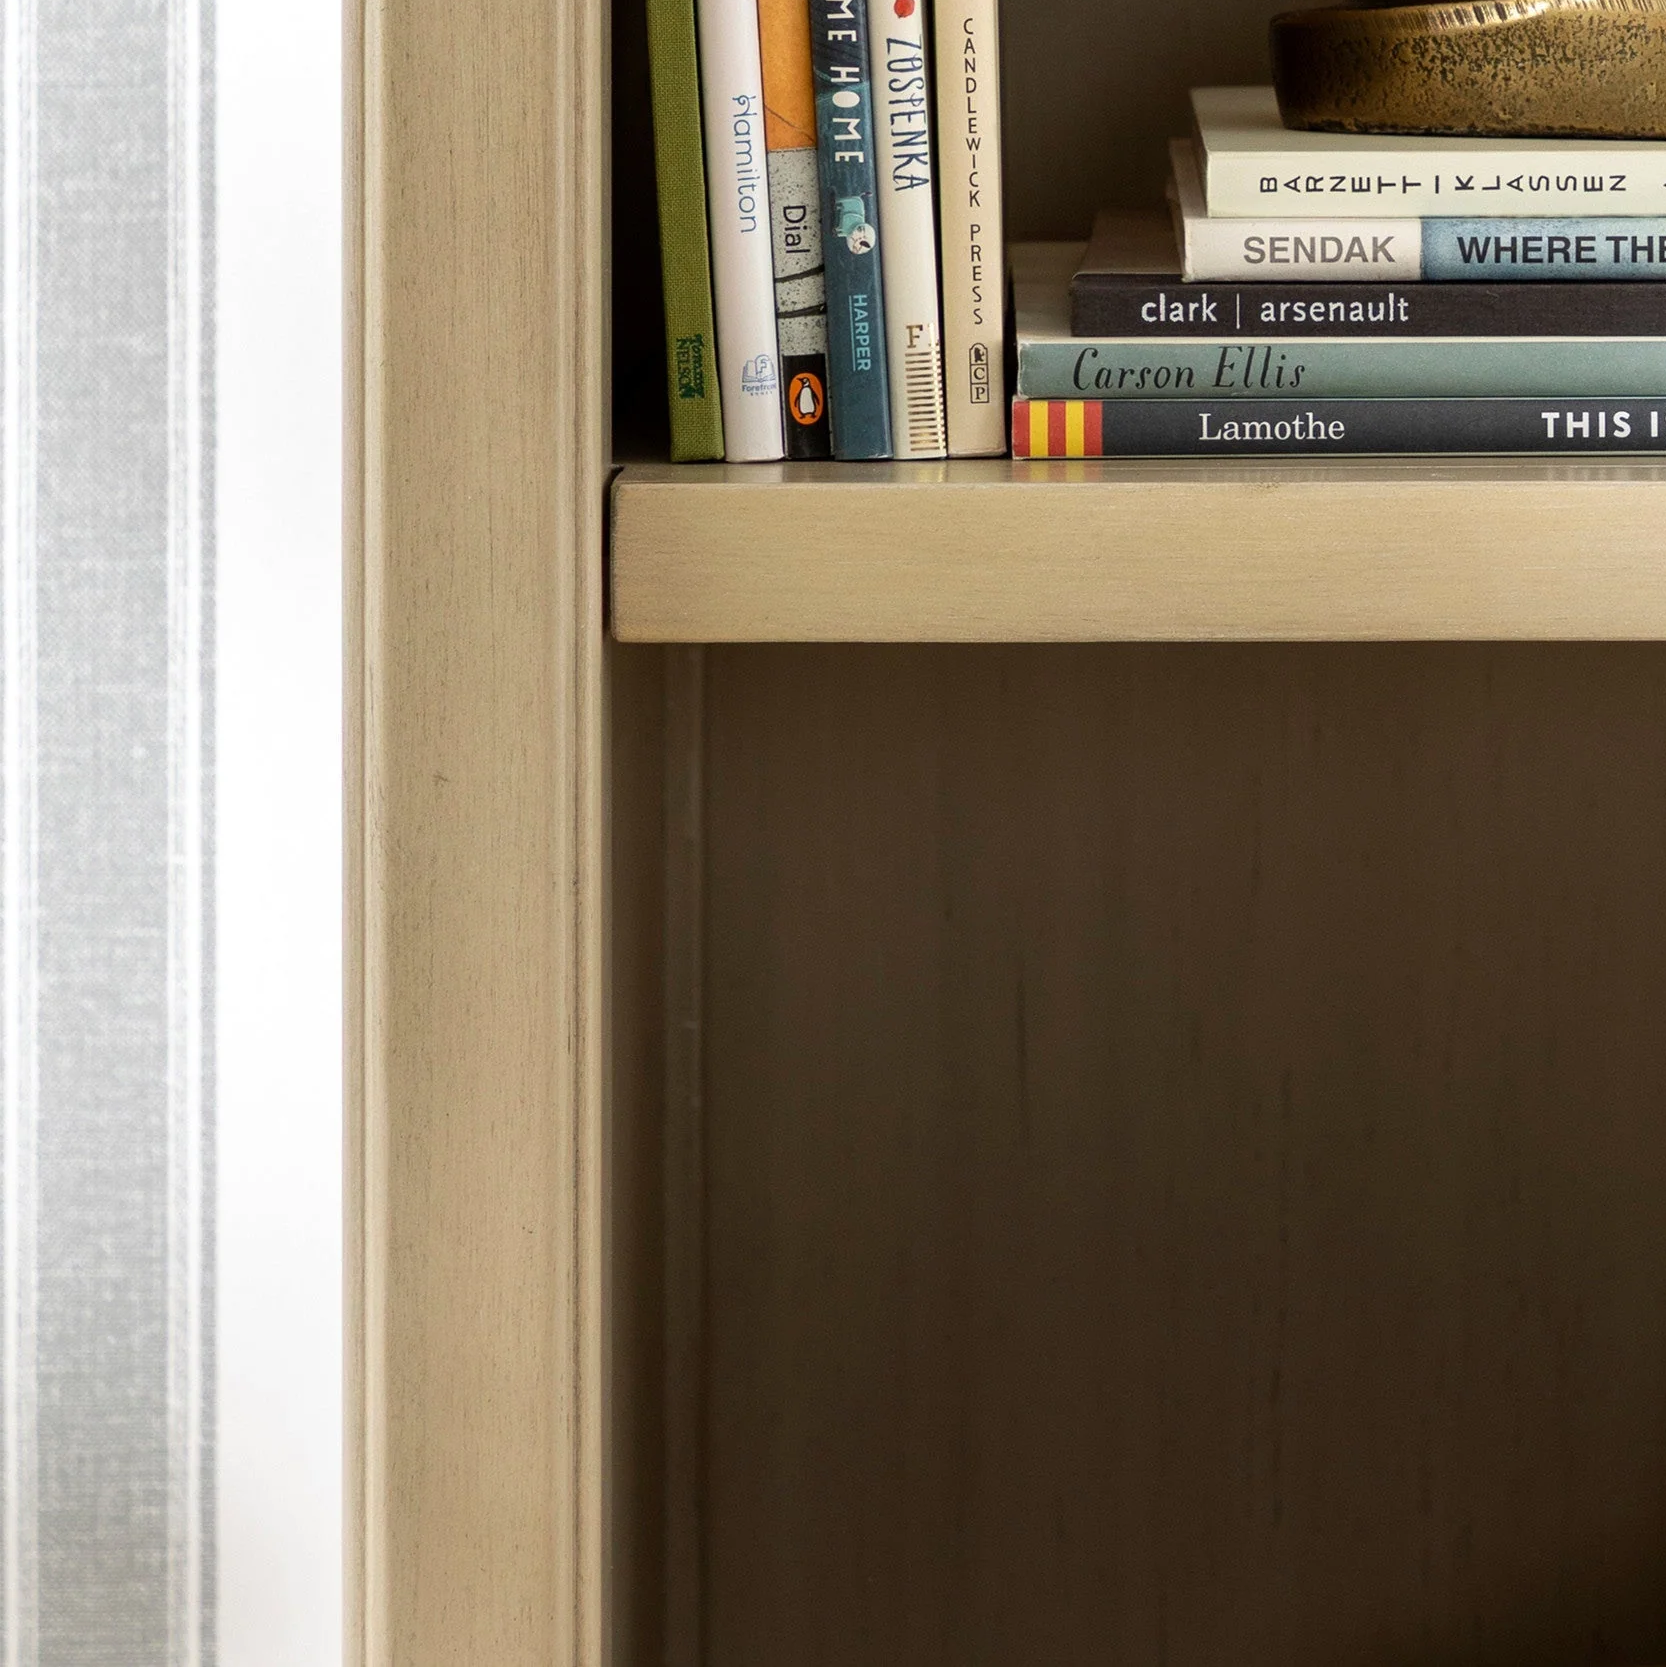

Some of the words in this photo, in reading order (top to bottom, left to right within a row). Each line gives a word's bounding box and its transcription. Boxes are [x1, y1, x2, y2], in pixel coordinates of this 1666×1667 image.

[828, 65, 865, 165] HOME
[884, 33, 931, 194] ZOSIENKA
[962, 18, 981, 207] CANDLEWICK
[732, 93, 761, 235] Hamilton
[1259, 174, 1423, 194] BARNETT
[1454, 173, 1627, 193] KLASSEN
[782, 204, 810, 255] Dial
[1242, 234, 1397, 265] SENDAK
[1457, 234, 1597, 265] WHERE
[969, 224, 985, 325] PRESS
[1140, 292, 1218, 323] clark
[1260, 293, 1409, 323] arsenault
[851, 293, 870, 372] HARPER
[1072, 346, 1196, 392] Carson
[1211, 344, 1306, 390] Ellis
[1198, 412, 1346, 441] Lamothe
[1541, 410, 1632, 439] THIS
